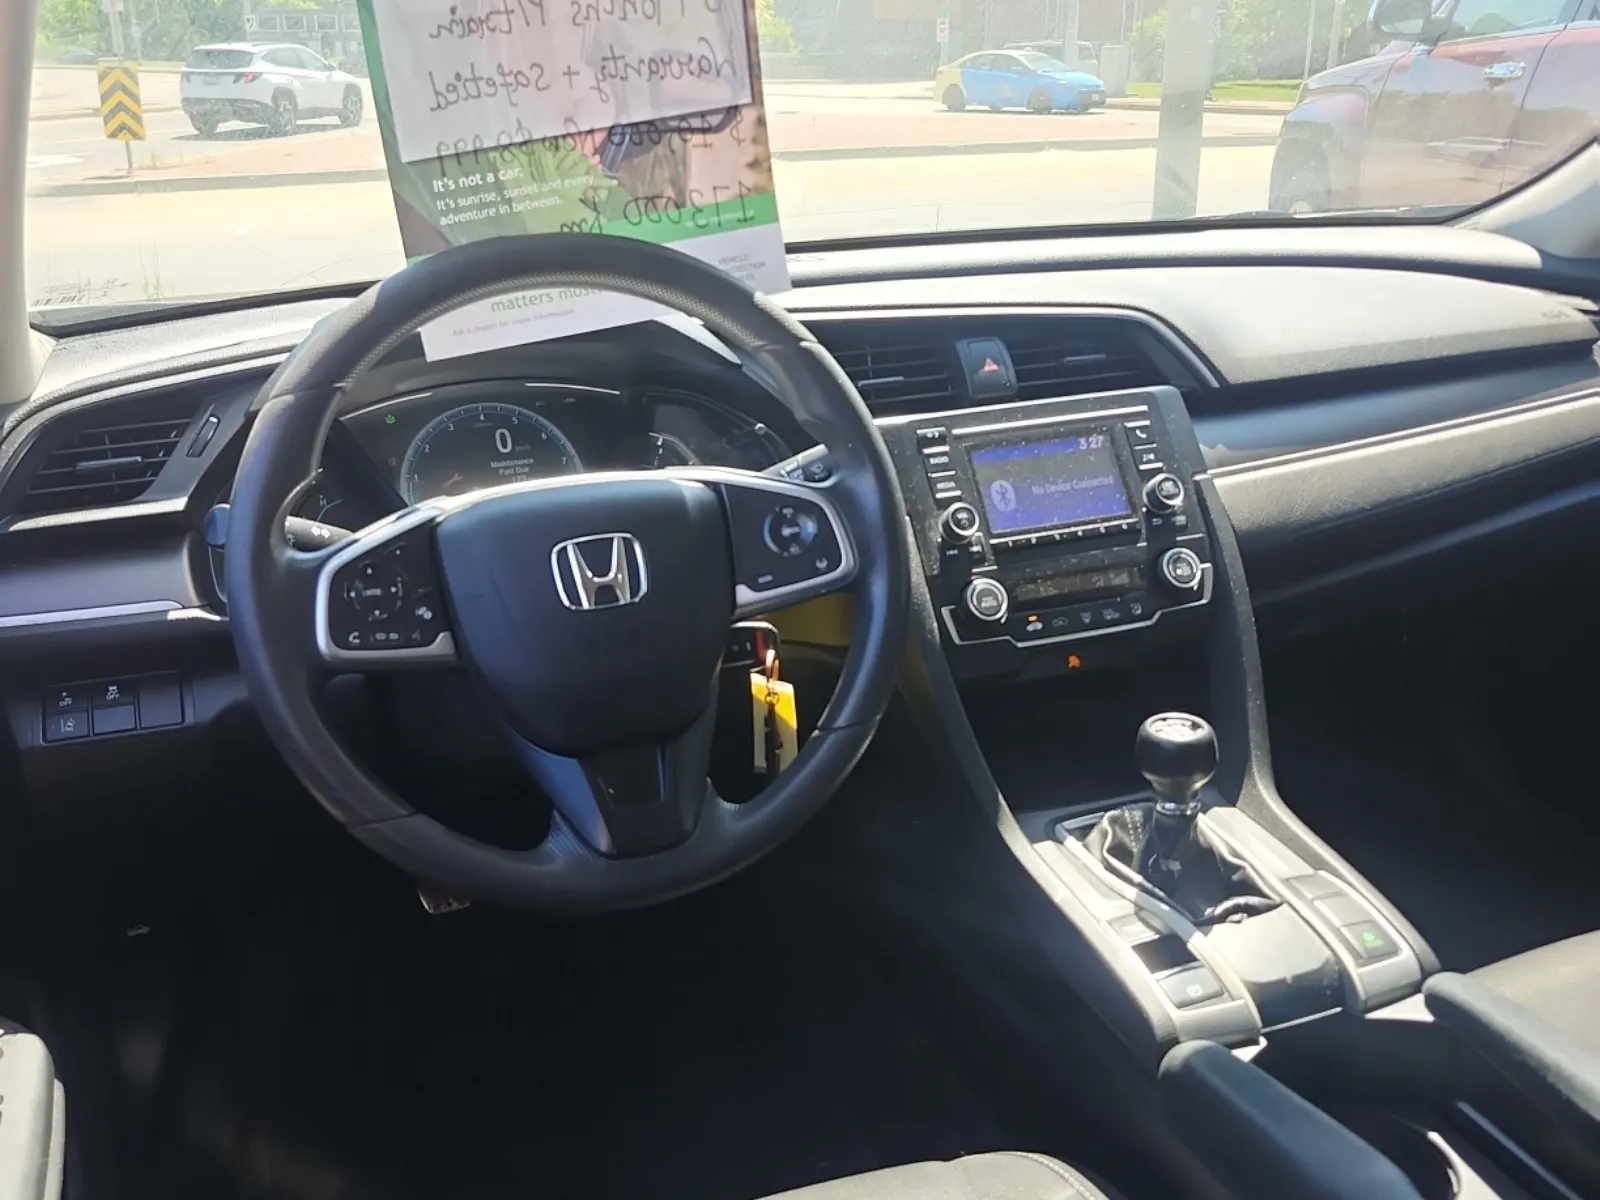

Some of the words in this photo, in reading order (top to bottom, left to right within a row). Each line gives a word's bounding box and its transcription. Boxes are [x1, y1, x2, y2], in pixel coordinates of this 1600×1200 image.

[432, 178, 456, 193] It's
[459, 173, 483, 188] not
[486, 172, 495, 183] a
[498, 167, 524, 180] car.
[436, 199, 455, 211] It's
[457, 191, 501, 207] sunrise,
[503, 184, 538, 197] sunset
[541, 179, 562, 192] and
[440, 206, 497, 226] adventure
[499, 203, 510, 215] in
[512, 195, 564, 213] between.
[491, 290, 555, 313] matters
[494, 428, 513, 454] 0
